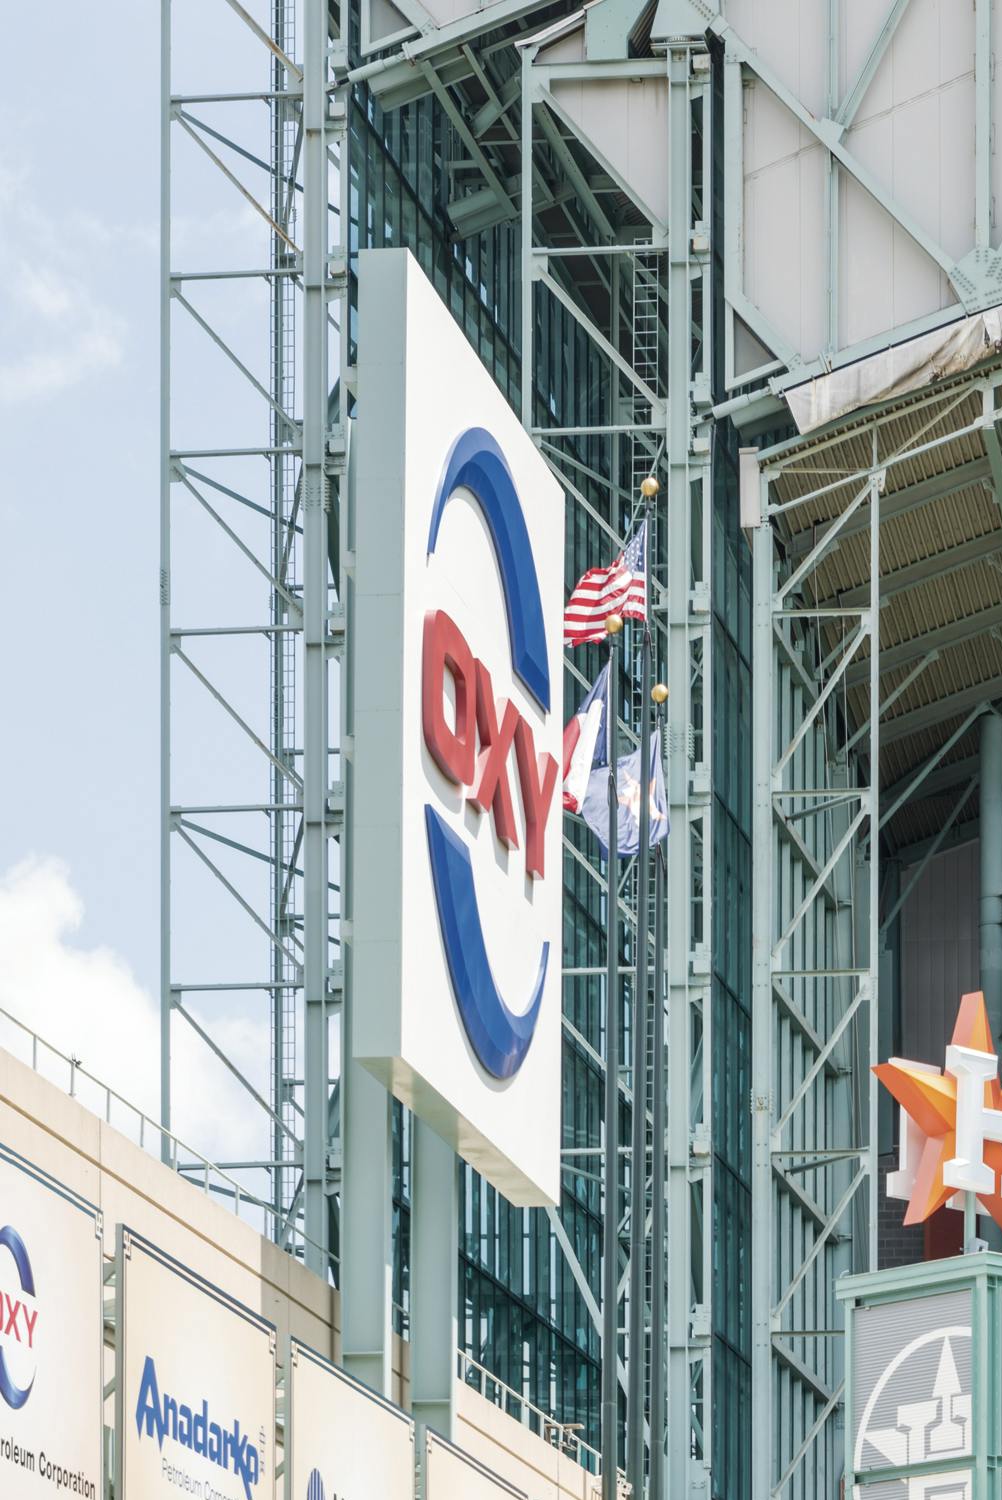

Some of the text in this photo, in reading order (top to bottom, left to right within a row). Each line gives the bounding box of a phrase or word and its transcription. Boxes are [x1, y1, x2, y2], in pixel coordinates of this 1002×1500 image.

[422, 608, 559, 882] OXY
[0, 1436, 36, 1473] roleum
[161, 1457, 203, 1496] Petroleum
